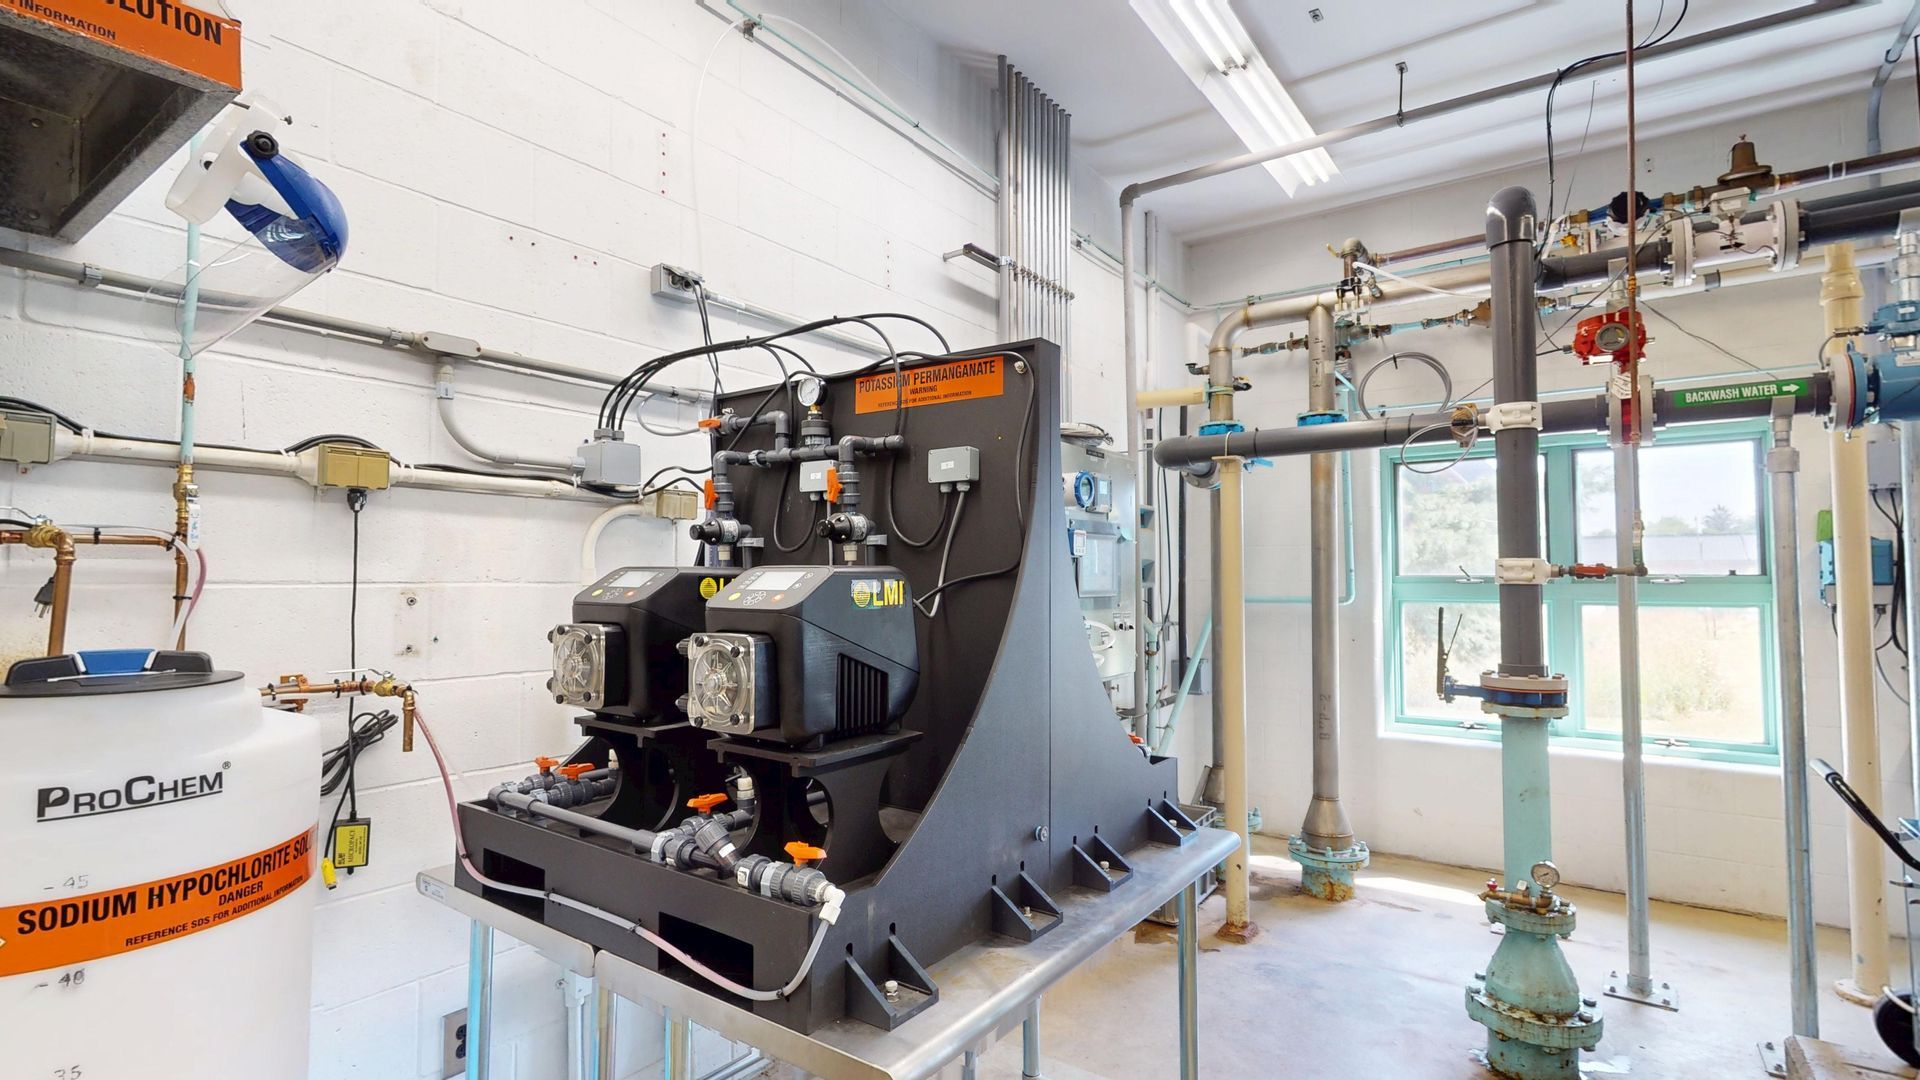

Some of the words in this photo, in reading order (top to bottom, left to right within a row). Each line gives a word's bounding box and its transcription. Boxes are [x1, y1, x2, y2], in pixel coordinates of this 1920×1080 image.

[19, 0, 116, 40] INFORMATION
[859, 374, 911, 393] POTASSIM
[913, 360, 995, 385] PERMANGANATE
[910, 385, 938, 395] WARNING
[1685, 388, 1740, 403] BACKWASH
[1741, 384, 1778, 397] WATER
[872, 580, 904, 606] LMI
[17, 891, 137, 935] SODIUM
[147, 844, 290, 909] HYPOCHLORITE
[218, 881, 263, 906] DANGER
[125, 923, 188, 947] REFERENCE
[191, 916, 210, 929] SDS
[213, 909, 229, 922] FOR
[232, 894, 272, 916] ADDITIONAL
